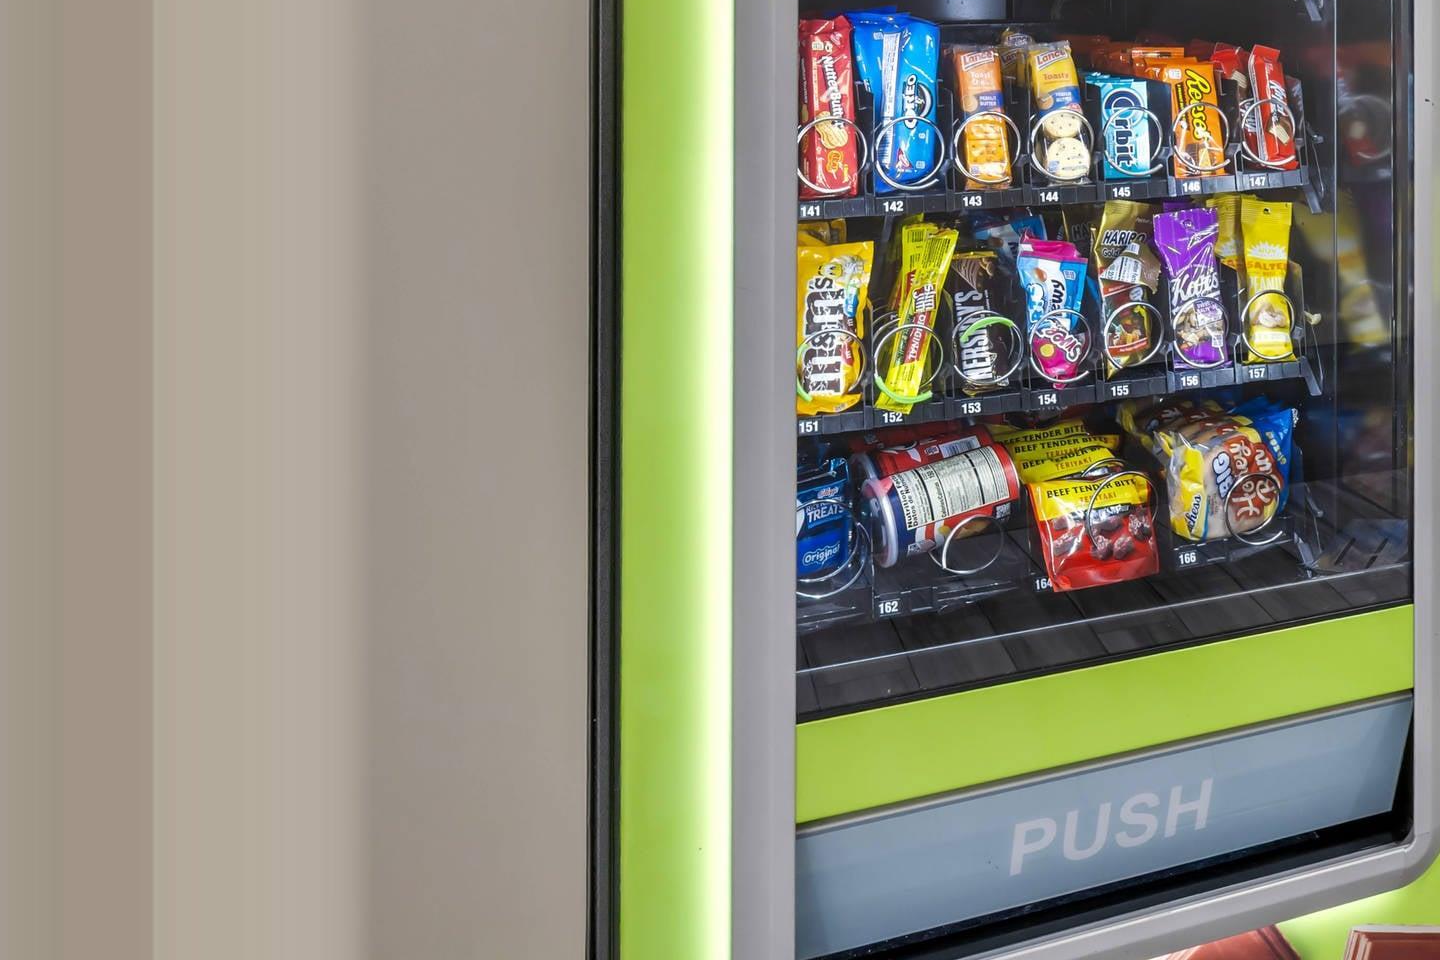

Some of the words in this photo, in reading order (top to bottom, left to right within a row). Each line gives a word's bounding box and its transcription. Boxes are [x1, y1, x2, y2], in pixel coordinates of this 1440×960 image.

[962, 51, 994, 66] Lance
[1036, 50, 1068, 66] Lance
[1182, 181, 1201, 193] 146
[1249, 176, 1267, 187] 147
[1039, 191, 1060, 202] 144
[1112, 186, 1131, 198] 145
[882, 200, 905, 212] 142
[962, 195, 983, 207] 143
[800, 204, 821, 217] 141
[1248, 367, 1266, 379] 157
[1181, 375, 1199, 387] 156
[1111, 385, 1129, 397] 155
[1038, 394, 1057, 406] 154
[961, 402, 981, 414] 153
[882, 412, 903, 423] 152
[799, 421, 818, 432] 151
[1022, 430, 1062, 442] TENDER
[1014, 443, 1040, 454] BEEF
[1040, 439, 1080, 450] TENDER
[1022, 459, 1049, 470] BEEF
[1055, 456, 1093, 471] TERIYAKI
[1212, 451, 1234, 499] BIG
[1046, 486, 1071, 499] BEEF
[899, 489, 913, 529] Nutrition
[804, 543, 841, 566] Original
[1178, 551, 1197, 564] 166
[878, 601, 899, 614] 162
[1010, 777, 1212, 878] PUSH
